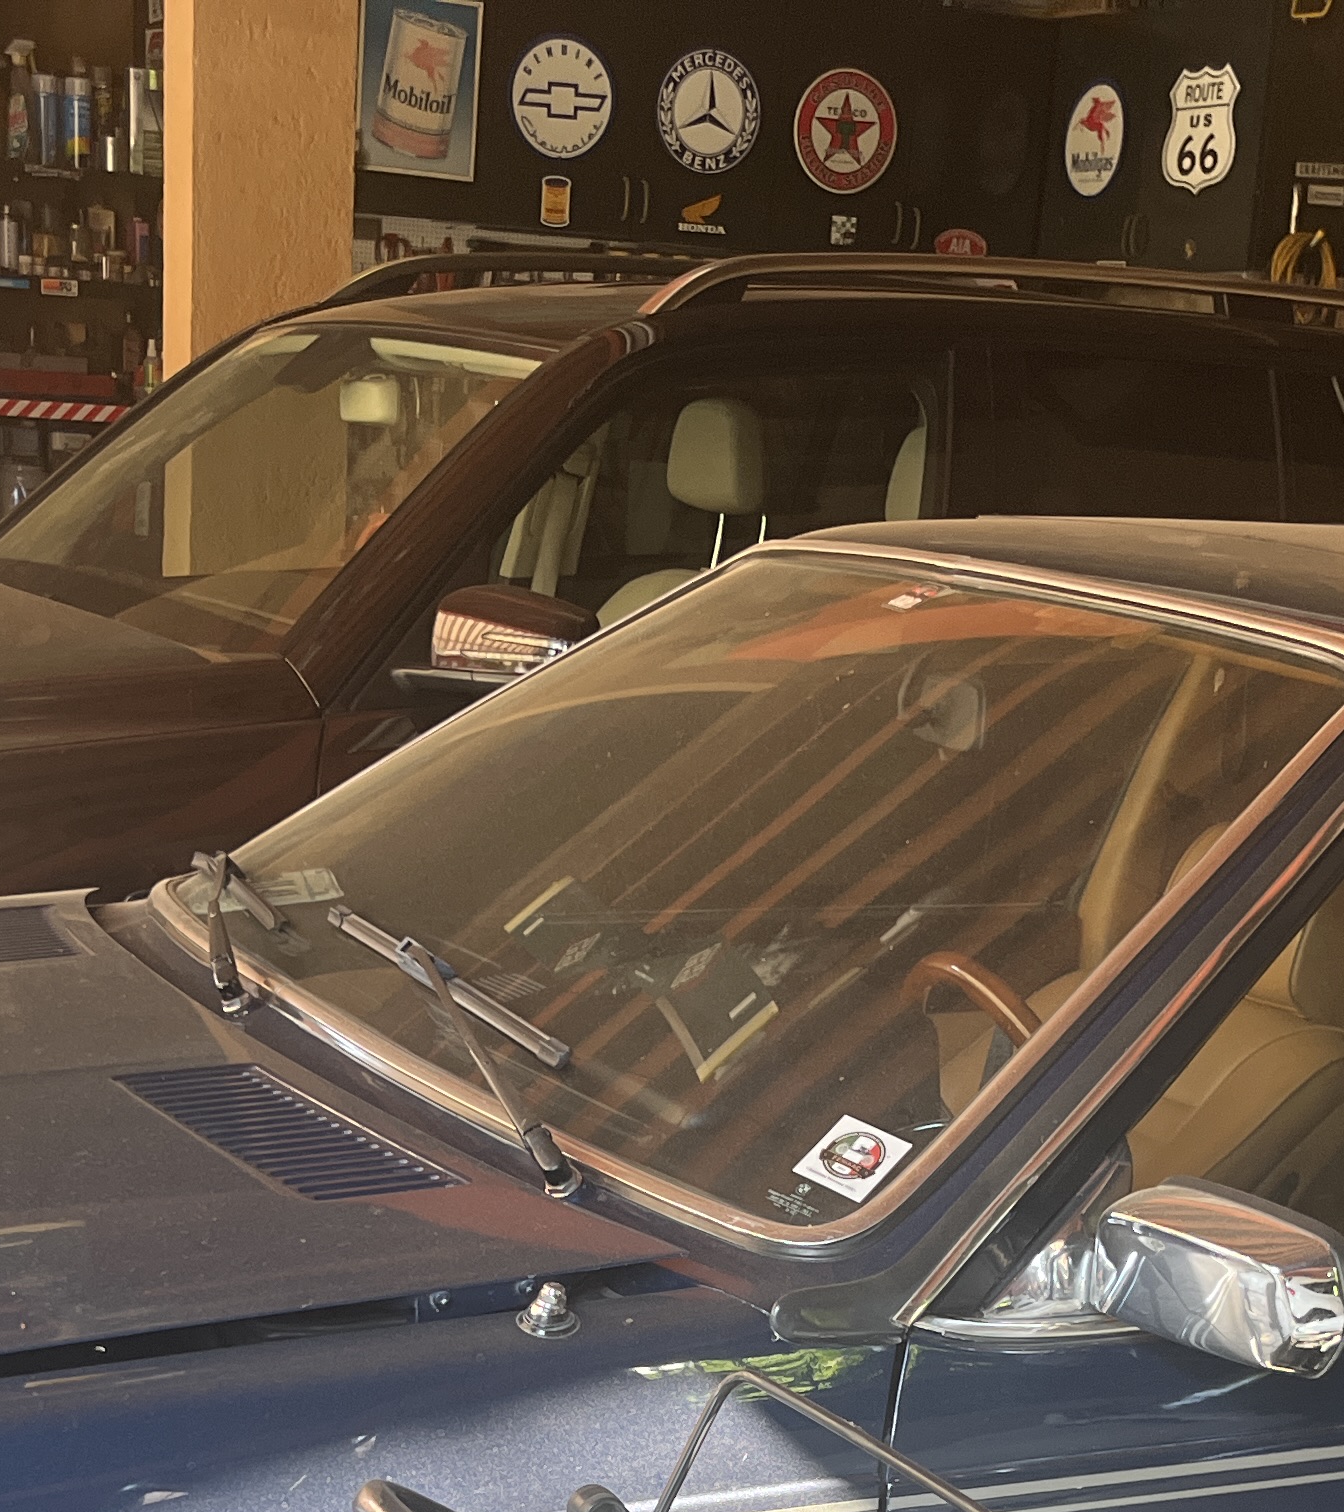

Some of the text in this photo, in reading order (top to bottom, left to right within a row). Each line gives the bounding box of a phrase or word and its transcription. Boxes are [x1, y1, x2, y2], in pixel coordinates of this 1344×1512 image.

[671, 52, 751, 91] MERCEDES
[383, 73, 452, 114] Mobiloil
[1184, 81, 1225, 104] ROUTE
[1189, 113, 1213, 129] US
[682, 152, 727, 171] BENZ
[1177, 132, 1219, 177] 66
[678, 222, 726, 235] HONDA
